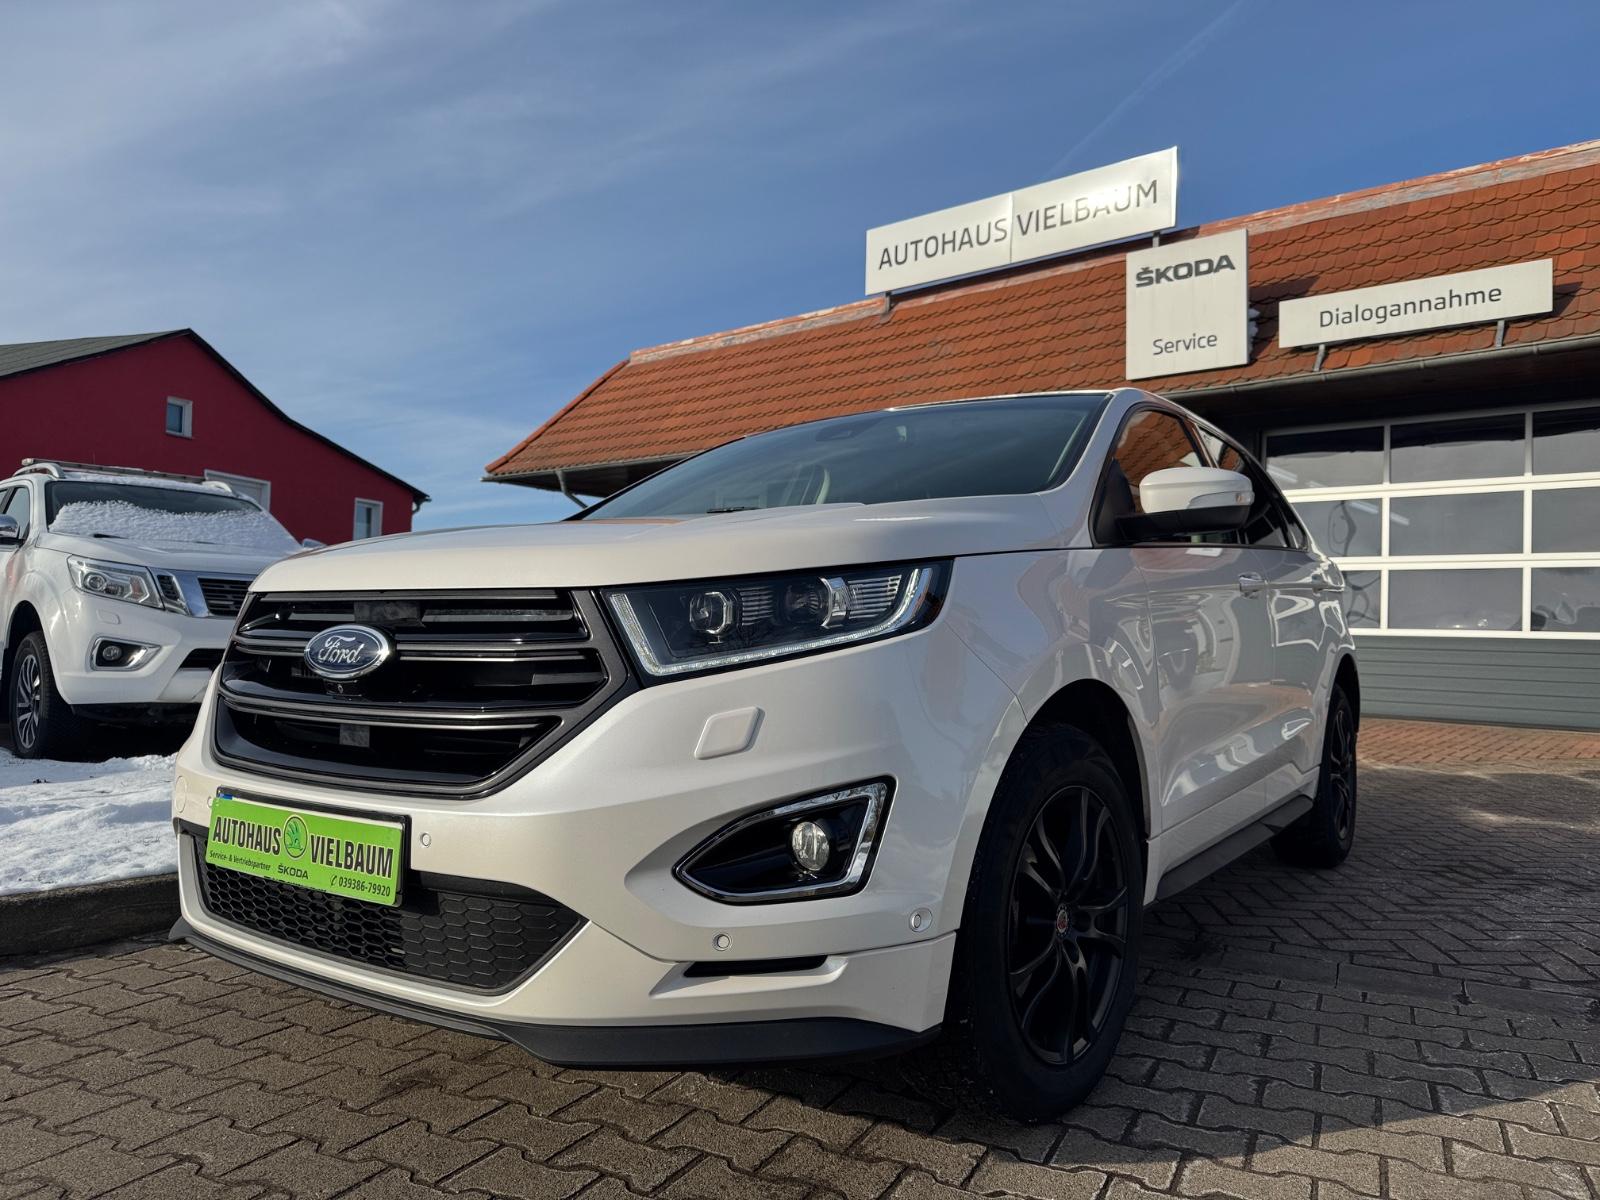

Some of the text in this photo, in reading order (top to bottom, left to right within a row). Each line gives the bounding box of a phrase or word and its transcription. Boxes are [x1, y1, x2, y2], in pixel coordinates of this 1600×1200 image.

[878, 218, 1008, 270] AUTOHAUS
[1135, 254, 1236, 289] ŠKODA
[1319, 285, 1503, 328] Dialogannahme
[1152, 332, 1219, 356] Service
[318, 635, 366, 663] Ford
[213, 816, 394, 879] AUTOHAUS VIELBAUM
[277, 863, 309, 880] ŠKODA
[338, 876, 391, 897] 039386-79920
